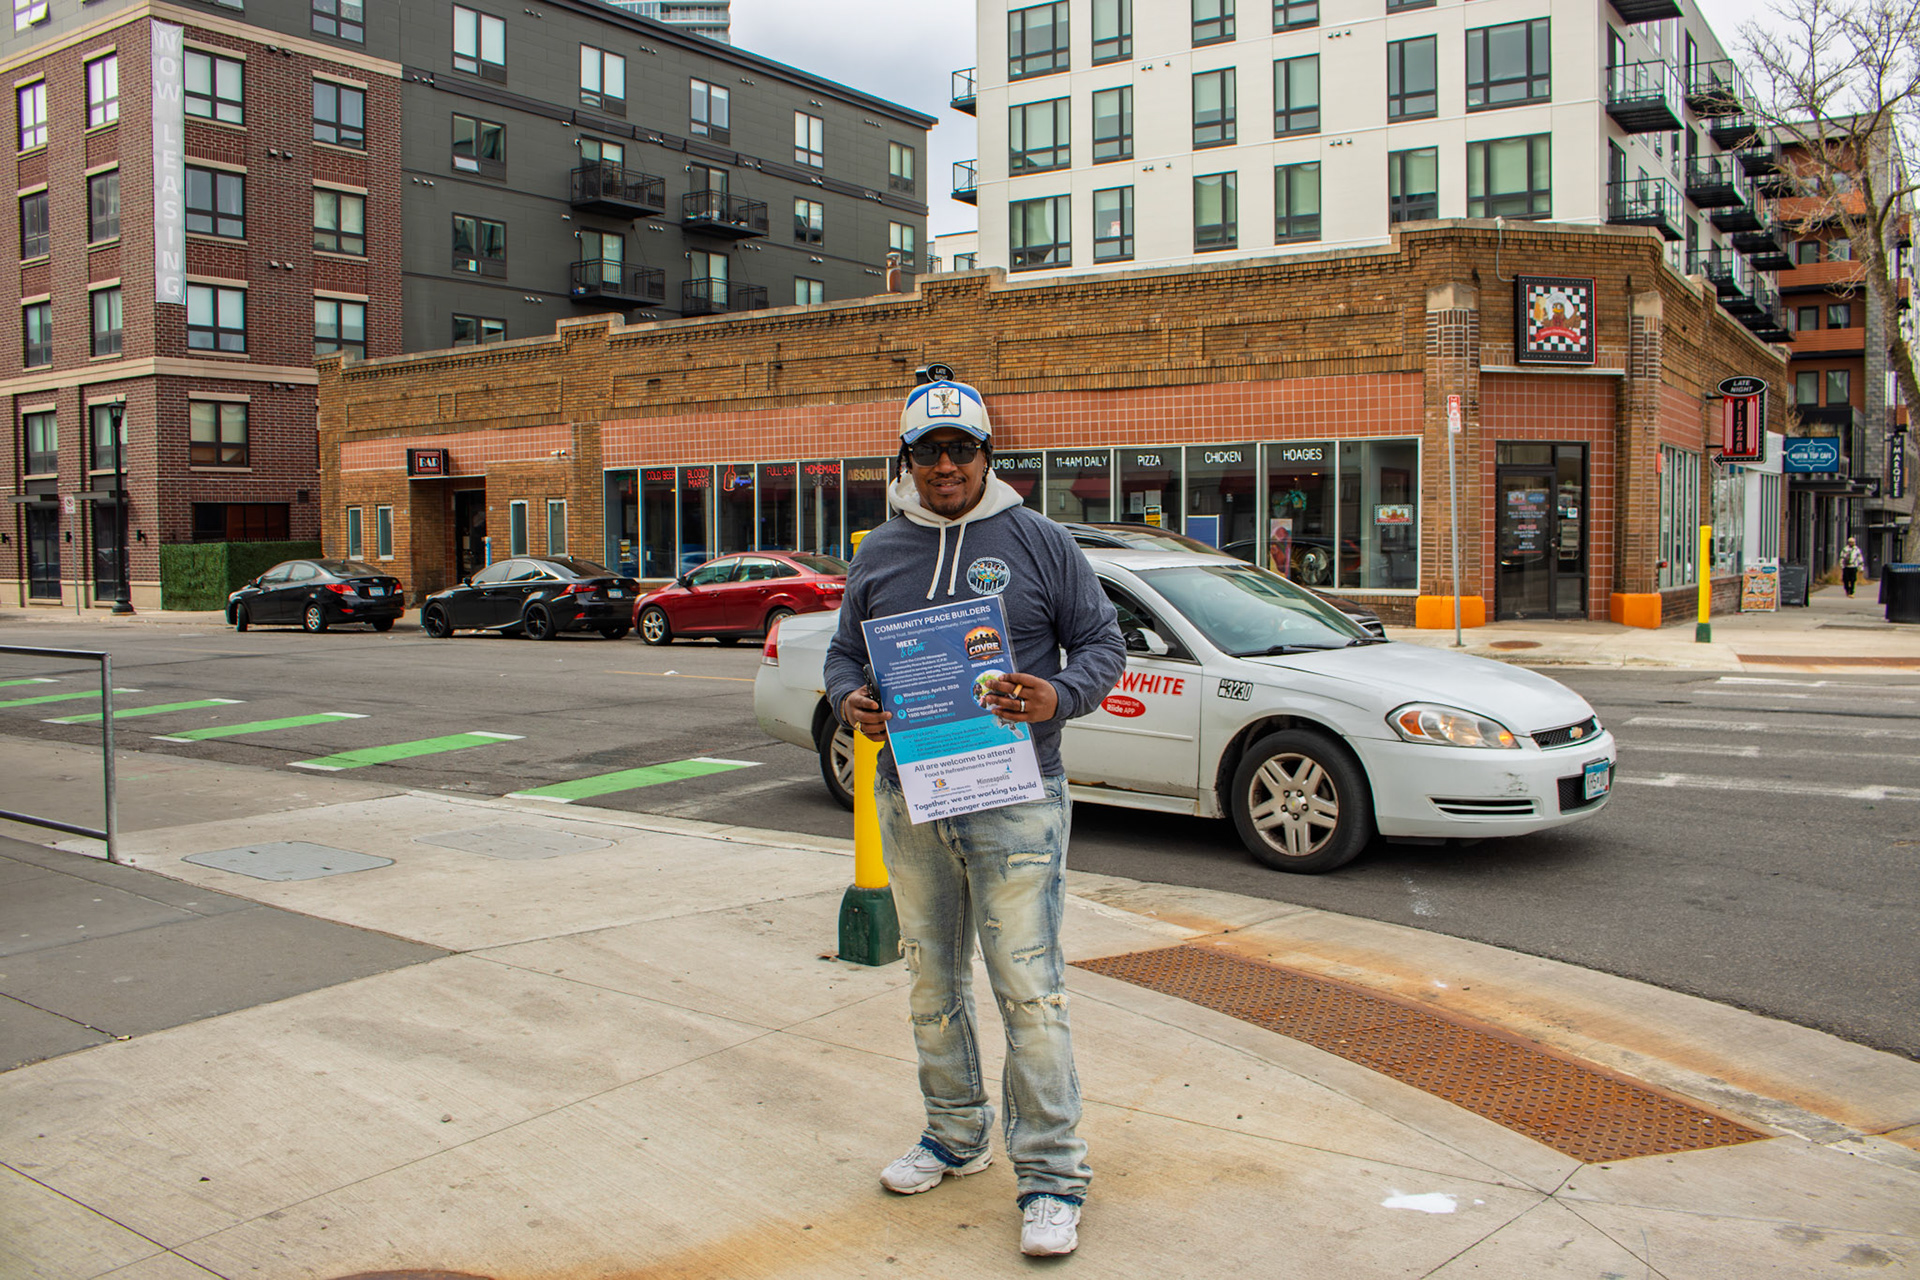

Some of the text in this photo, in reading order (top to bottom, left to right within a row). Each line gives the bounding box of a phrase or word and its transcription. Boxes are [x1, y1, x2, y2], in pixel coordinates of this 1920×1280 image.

[155, 32, 180, 295] NOW LEASING
[1736, 400, 1744, 452] PIZZA
[1137, 455, 1161, 466] PIZZA
[1205, 451, 1242, 463] CHICKEN
[1283, 448, 1322, 461] HOAGIES
[419, 457, 440, 468] BAR
[991, 457, 1042, 470] UMBO WINGS
[1056, 456, 1108, 467] 11-4AM DAILY
[646, 471, 661, 481] COLD
[687, 469, 710, 479] BLOODY
[766, 466, 796, 477] FULL BAR
[804, 464, 840, 475] HOMEMADE
[848, 468, 887, 481] ABSOLUT
[874, 605, 991, 634] COMMUNITY PEACE BUILDERS
[896, 639, 918, 649] MEET
[969, 640, 1000, 655] COVRE
[972, 658, 1004, 668] MINNEAPOLIS
[1122, 671, 1185, 696] WHITE
[1225, 680, 1253, 700] 3230
[906, 704, 934, 713] Community
[1107, 698, 1131, 706] DOWNLOAD
[1123, 707, 1136, 715] APP
[914, 765, 925, 773] All
[926, 762, 939, 770] are
[940, 755, 976, 768] welcome
[987, 747, 1016, 759] attend!
[945, 763, 985, 775] Refreshments
[986, 757, 1012, 767] Provided
[977, 773, 1010, 786] Minneapolis
[914, 799, 950, 811] Together,
[951, 795, 962, 803] we
[977, 786, 1008, 799] working
[1018, 781, 1037, 791] build
[927, 809, 949, 818] safer,
[949, 802, 980, 814] stronger
[981, 794, 1029, 807] communities.
